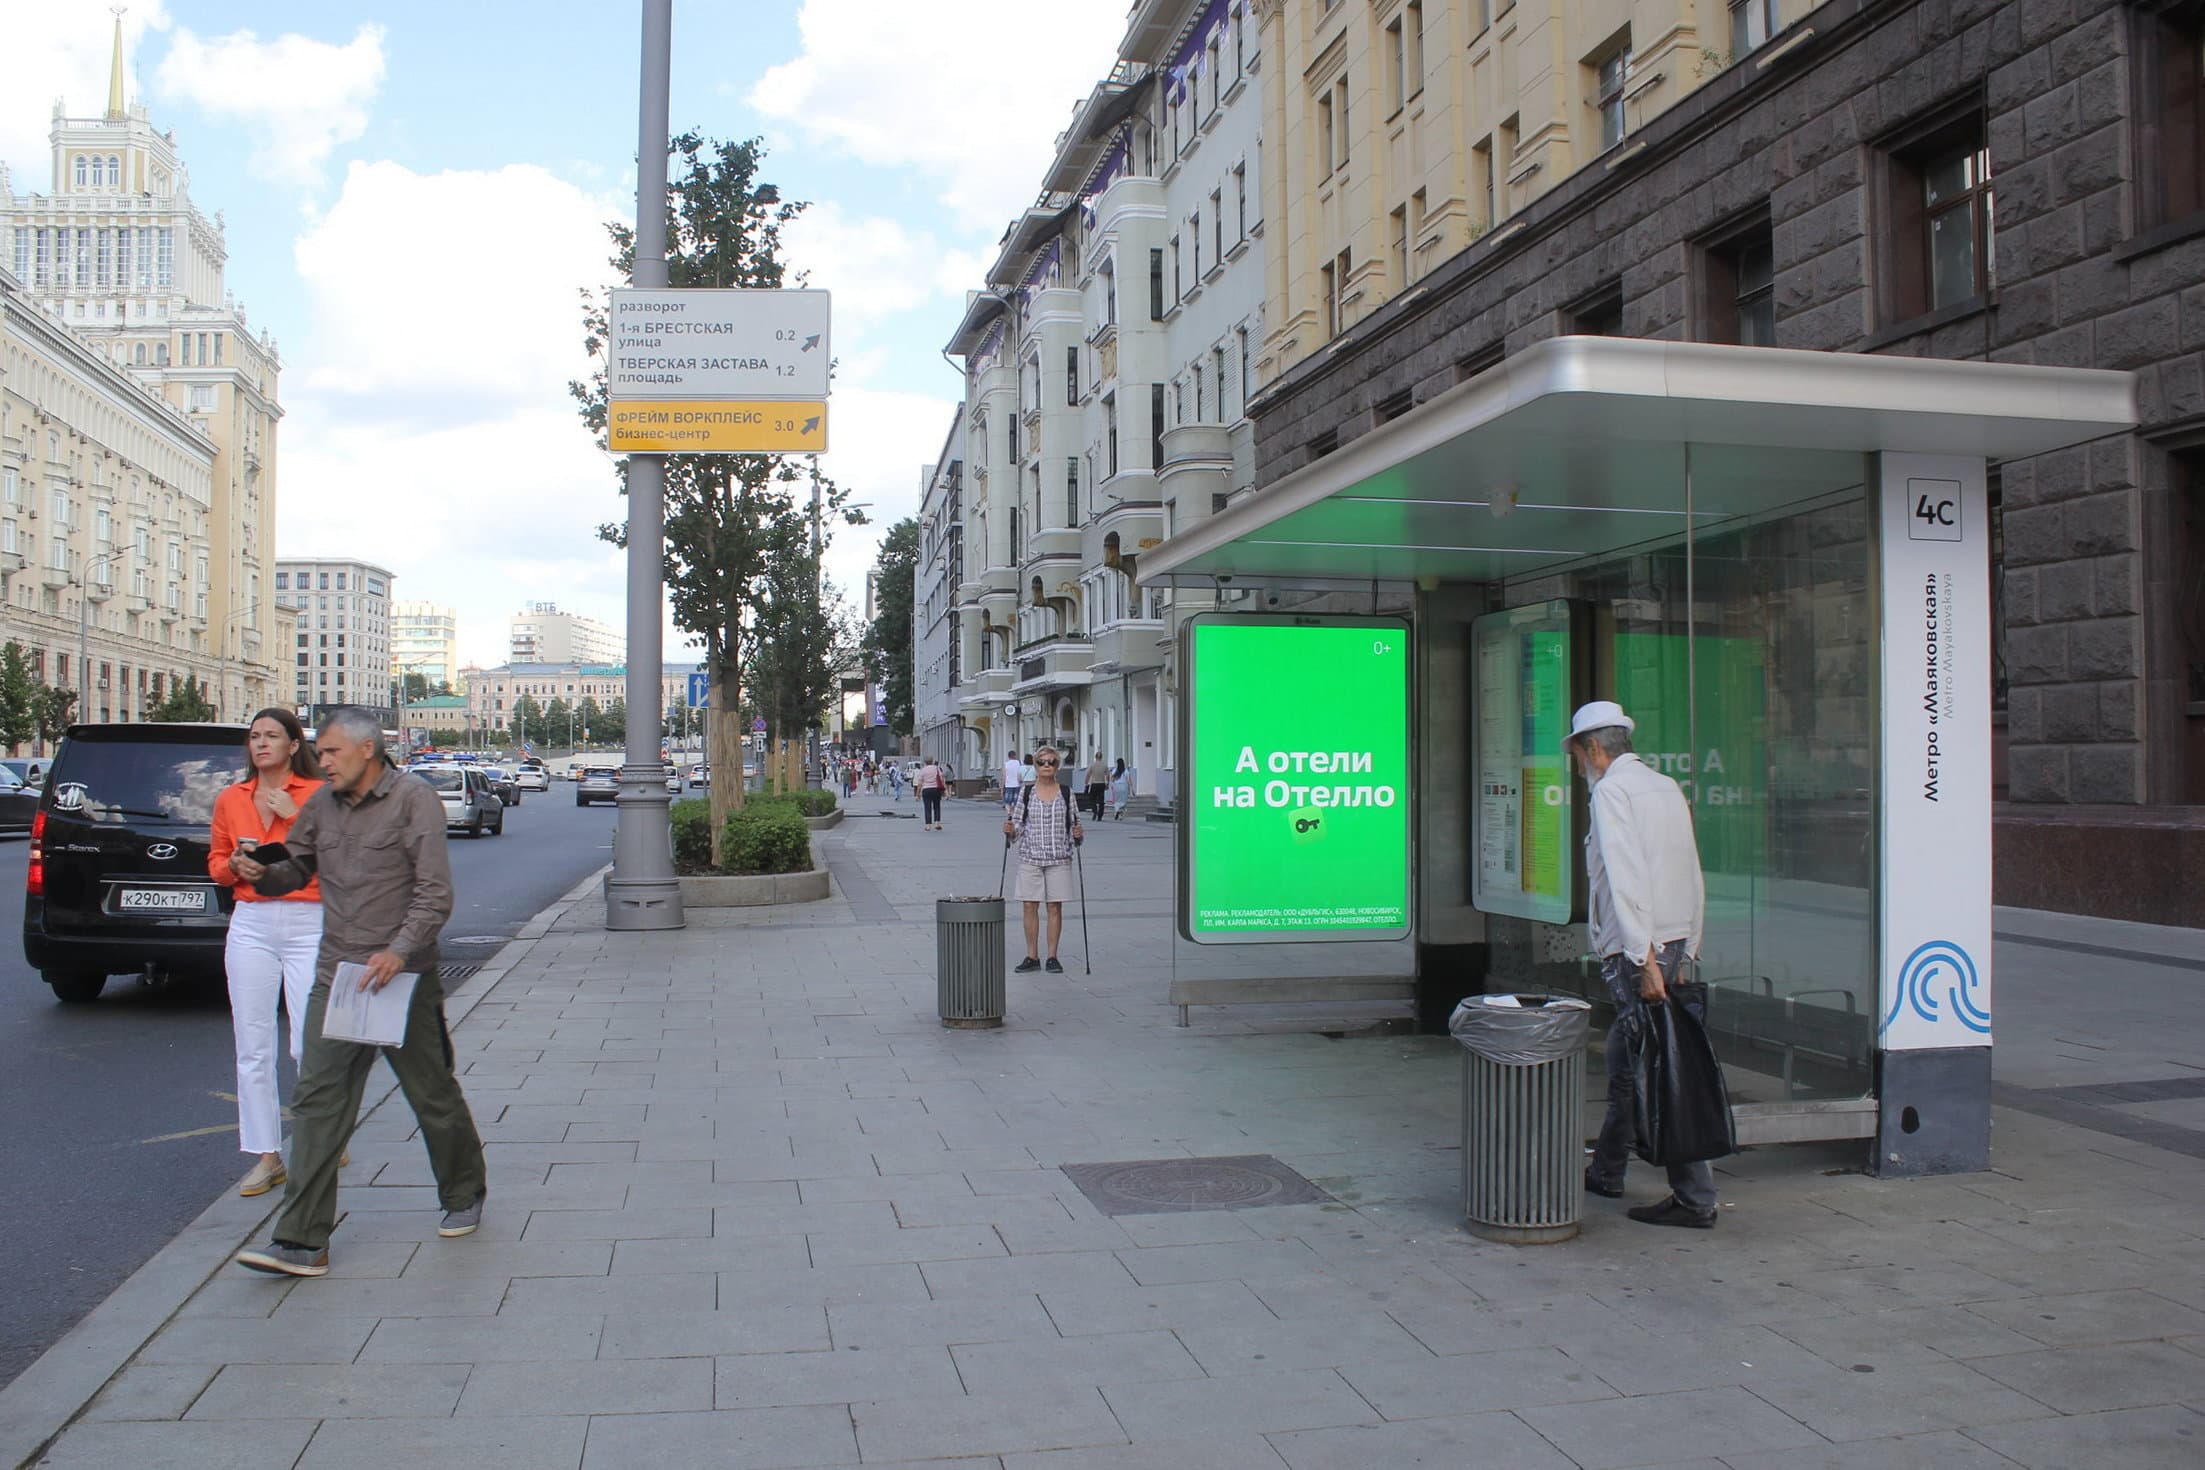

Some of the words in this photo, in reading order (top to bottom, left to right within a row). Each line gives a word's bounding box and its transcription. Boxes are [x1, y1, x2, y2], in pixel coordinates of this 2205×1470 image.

[619, 302, 686, 314] разворот
[619, 323, 640, 334] 1-я
[644, 322, 733, 334] БРЕСТСКАЯ
[775, 330, 796, 341] 0.2
[618, 337, 661, 349] улица
[618, 358, 697, 370] ТВЕРСКАЯ
[701, 358, 769, 370] ЗАСТАВА
[775, 365, 796, 377] 1.2
[618, 373, 683, 384] площадь
[616, 410, 669, 424] ФРЕЙМ
[673, 410, 763, 424] ВОРКПЛЕЙС
[774, 420, 794, 432] 3.0
[616, 429, 711, 440] бизнес-центр
[535, 602, 557, 612] ВТБ
[1942, 573, 1954, 673] Mayakovskaya
[1373, 641, 1391, 655] 0+
[1924, 573, 1939, 724] «Маяковская»
[1943, 676, 1953, 719] Metro
[1235, 746, 1259, 773] А
[1268, 750, 1373, 773] отели
[1924, 731, 1941, 802] Метро
[1214, 785, 1256, 808] на
[1264, 780, 1395, 808] Отелло
